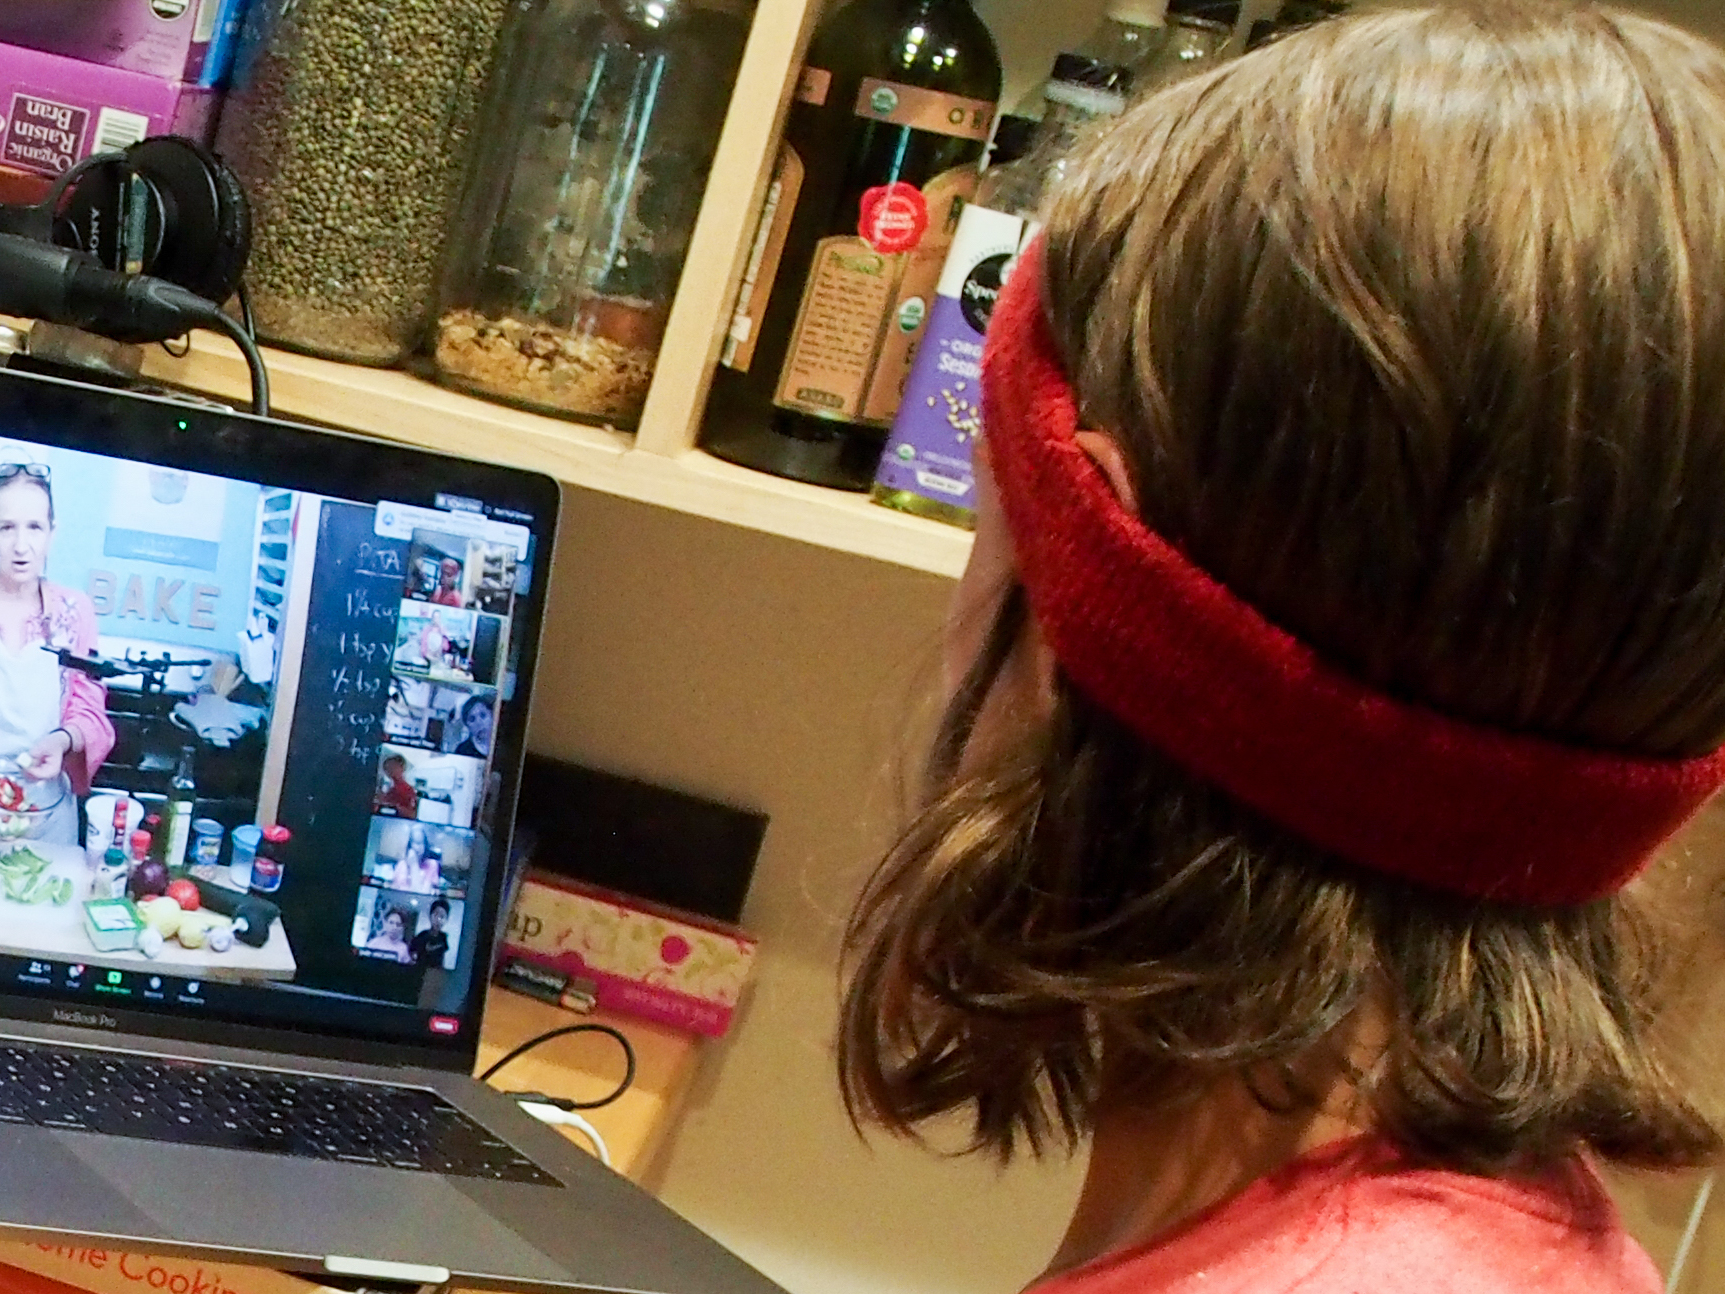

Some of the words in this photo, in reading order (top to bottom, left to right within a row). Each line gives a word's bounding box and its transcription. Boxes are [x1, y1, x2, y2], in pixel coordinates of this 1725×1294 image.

[26, 100, 73, 131] Bran
[14, 120, 76, 154] Raisin
[9, 142, 73, 172] Organic
[89, 569, 221, 631] BAKE
[99, 1013, 117, 1028] Pro
[22, 1241, 108, 1270] ome
